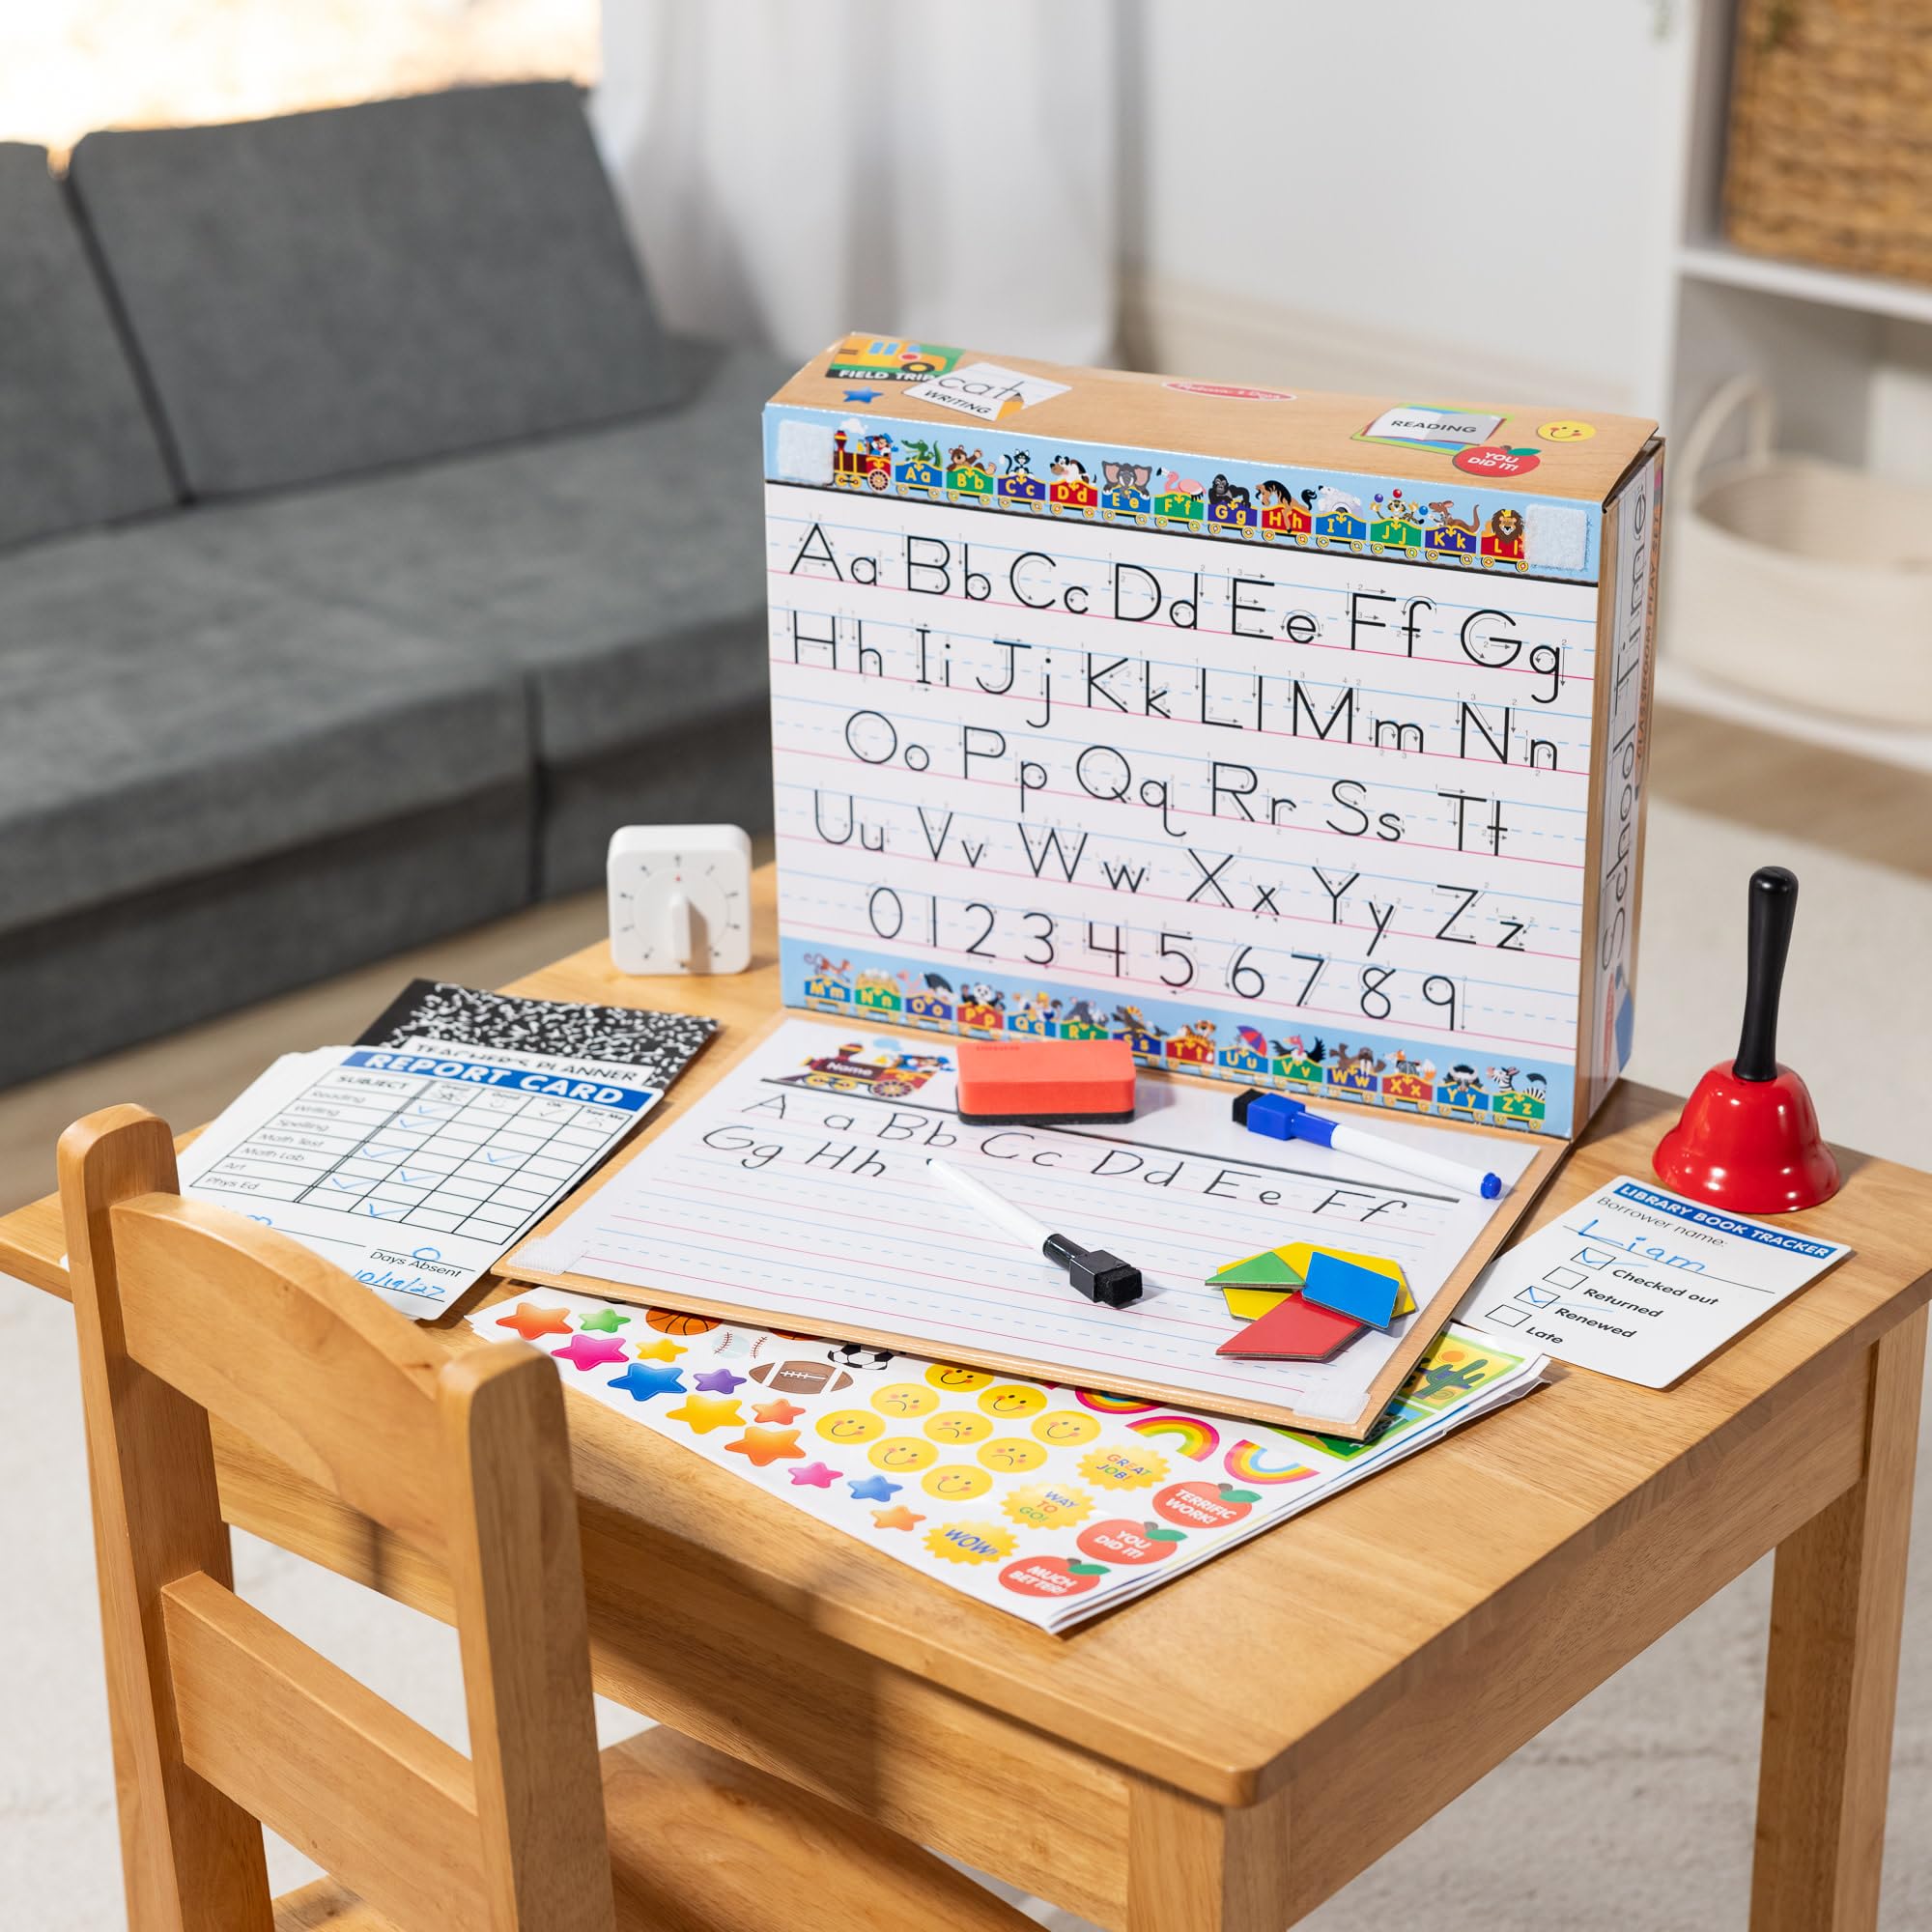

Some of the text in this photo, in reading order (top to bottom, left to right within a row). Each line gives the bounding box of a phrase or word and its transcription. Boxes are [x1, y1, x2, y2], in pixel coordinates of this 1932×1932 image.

[838, 369, 934, 383] FIELD TRIP
[938, 377, 1025, 399] cat
[925, 390, 991, 414] WRITING
[1390, 419, 1477, 434] READING
[1467, 457, 1519, 471] DID IT!
[1485, 452, 1519, 464] YOU
[1636, 512, 1661, 758] CLASSROOM PLAY SET
[1602, 494, 1647, 972] School Time
[364, 1054, 624, 1104] REPORT CARD
[827, 1062, 873, 1076] Name
[337, 1074, 411, 1091] SUBJECT
[276, 1119, 329, 1132] Spelling
[260, 1132, 294, 1144] Math
[241, 1147, 305, 1161] Math Lab
[224, 1162, 246, 1171] Art
[206, 1176, 260, 1190] Phys Ed
[1597, 1196, 1728, 1248] Borrower name:
[1619, 1184, 1830, 1259] LIBRARY BOOK TRACKER
[1577, 1218, 1707, 1271] Liam
[370, 1251, 462, 1278] Days Absent
[1611, 1268, 1719, 1306] Checked out
[1583, 1288, 1664, 1318] Returned
[1555, 1307, 1637, 1339] Renewed
[1525, 1326, 1563, 1345] Late
[1095, 1463, 1132, 1482] JOB!
[1106, 1454, 1152, 1476] GREAT
[1037, 1500, 1058, 1513] TO
[1044, 1490, 1080, 1508] WAY
[1174, 1488, 1237, 1520] TERRIFIC
[1019, 1505, 1048, 1522] GO!
[1165, 1498, 1216, 1524] WORK!
[944, 1528, 999, 1556] WOW!
[1094, 1534, 1144, 1559] DID IT!
[1116, 1530, 1152, 1549] YOU
[1008, 1570, 1067, 1595] BETTER!
[1026, 1565, 1078, 1588] MUCH
